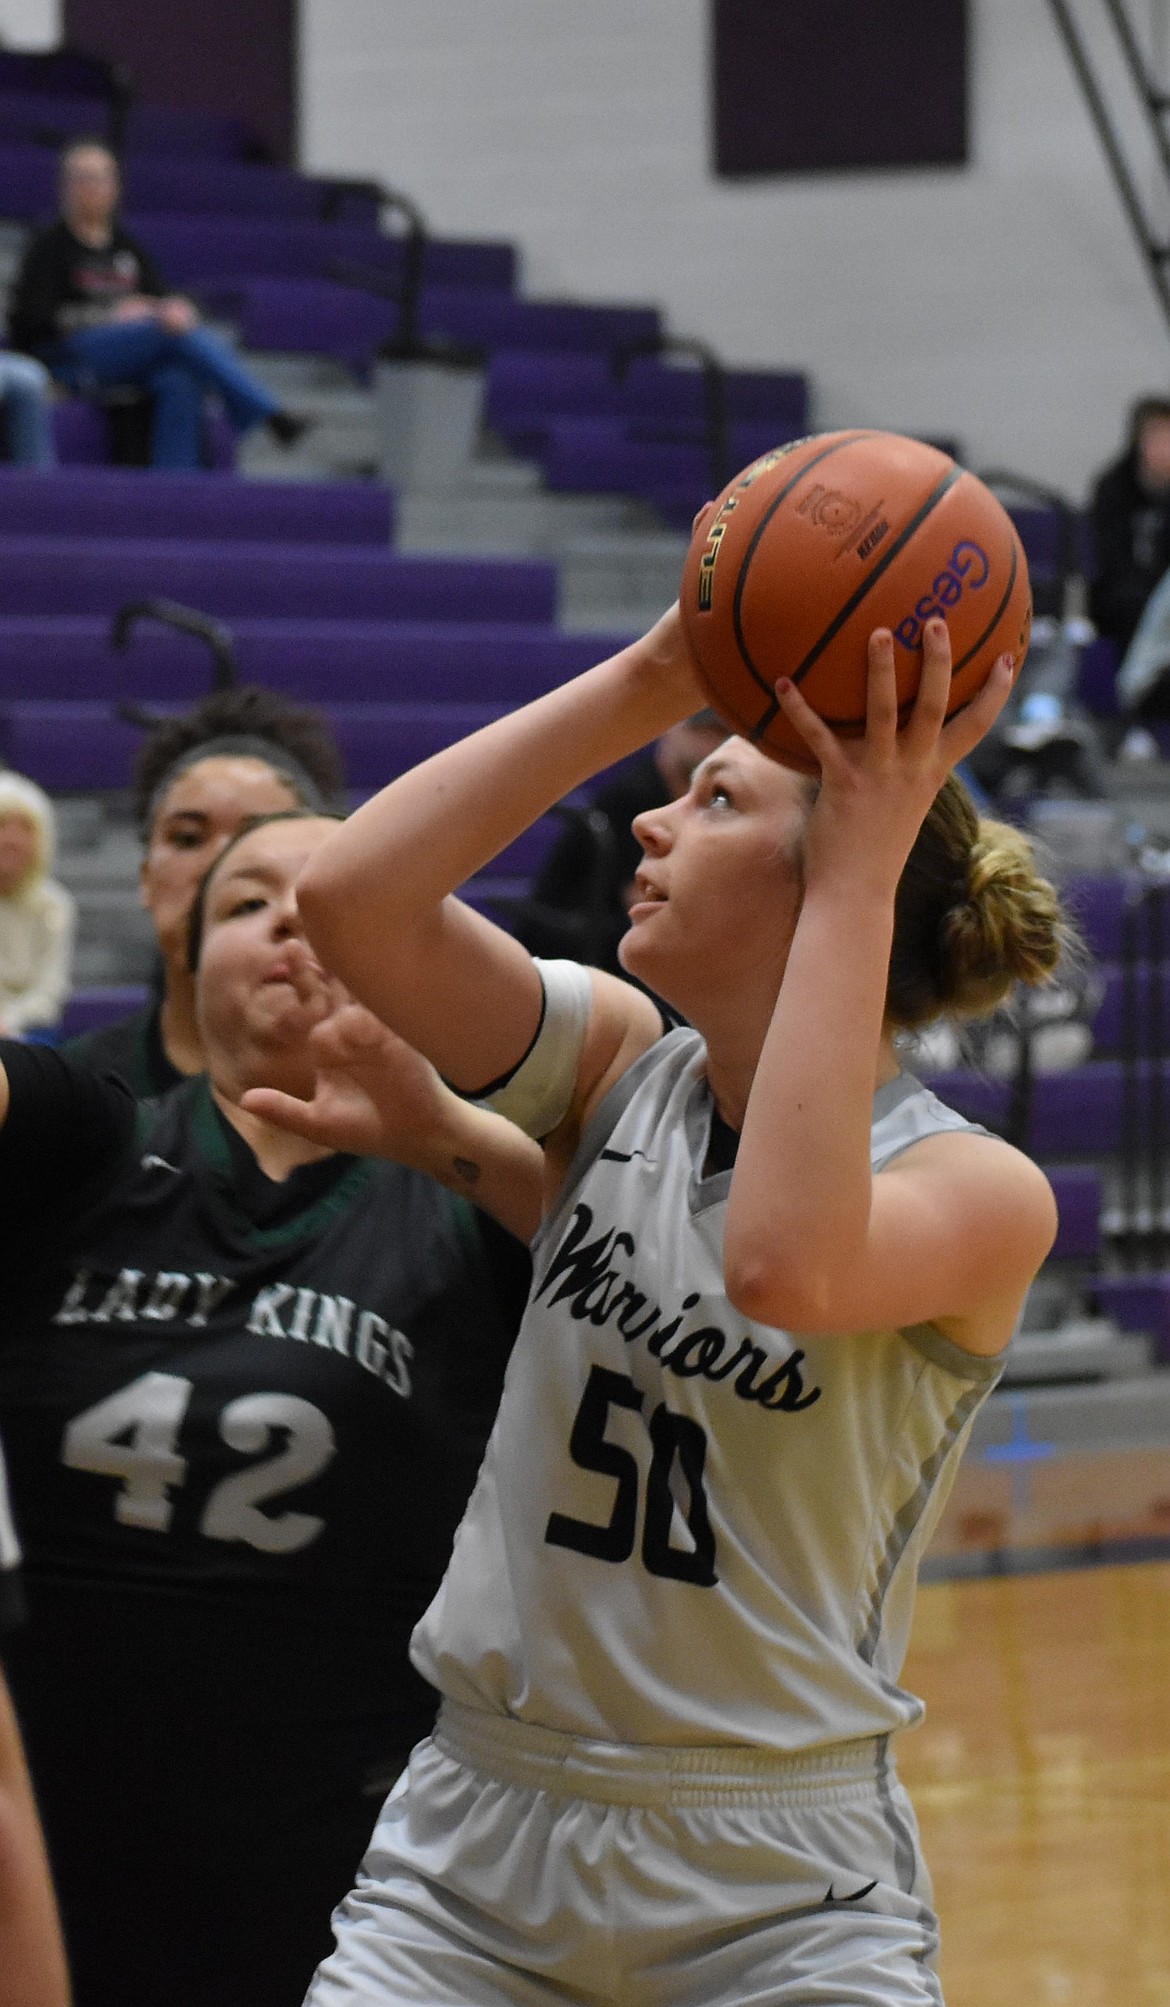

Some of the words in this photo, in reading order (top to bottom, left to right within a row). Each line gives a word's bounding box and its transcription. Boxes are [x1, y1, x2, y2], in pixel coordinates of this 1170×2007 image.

[894, 540, 990, 652] Gesa
[53, 1266, 238, 1328] LADY
[245, 1281, 415, 1399] KINGS
[61, 1371, 338, 1554] 42
[544, 1364, 719, 1588] 50
